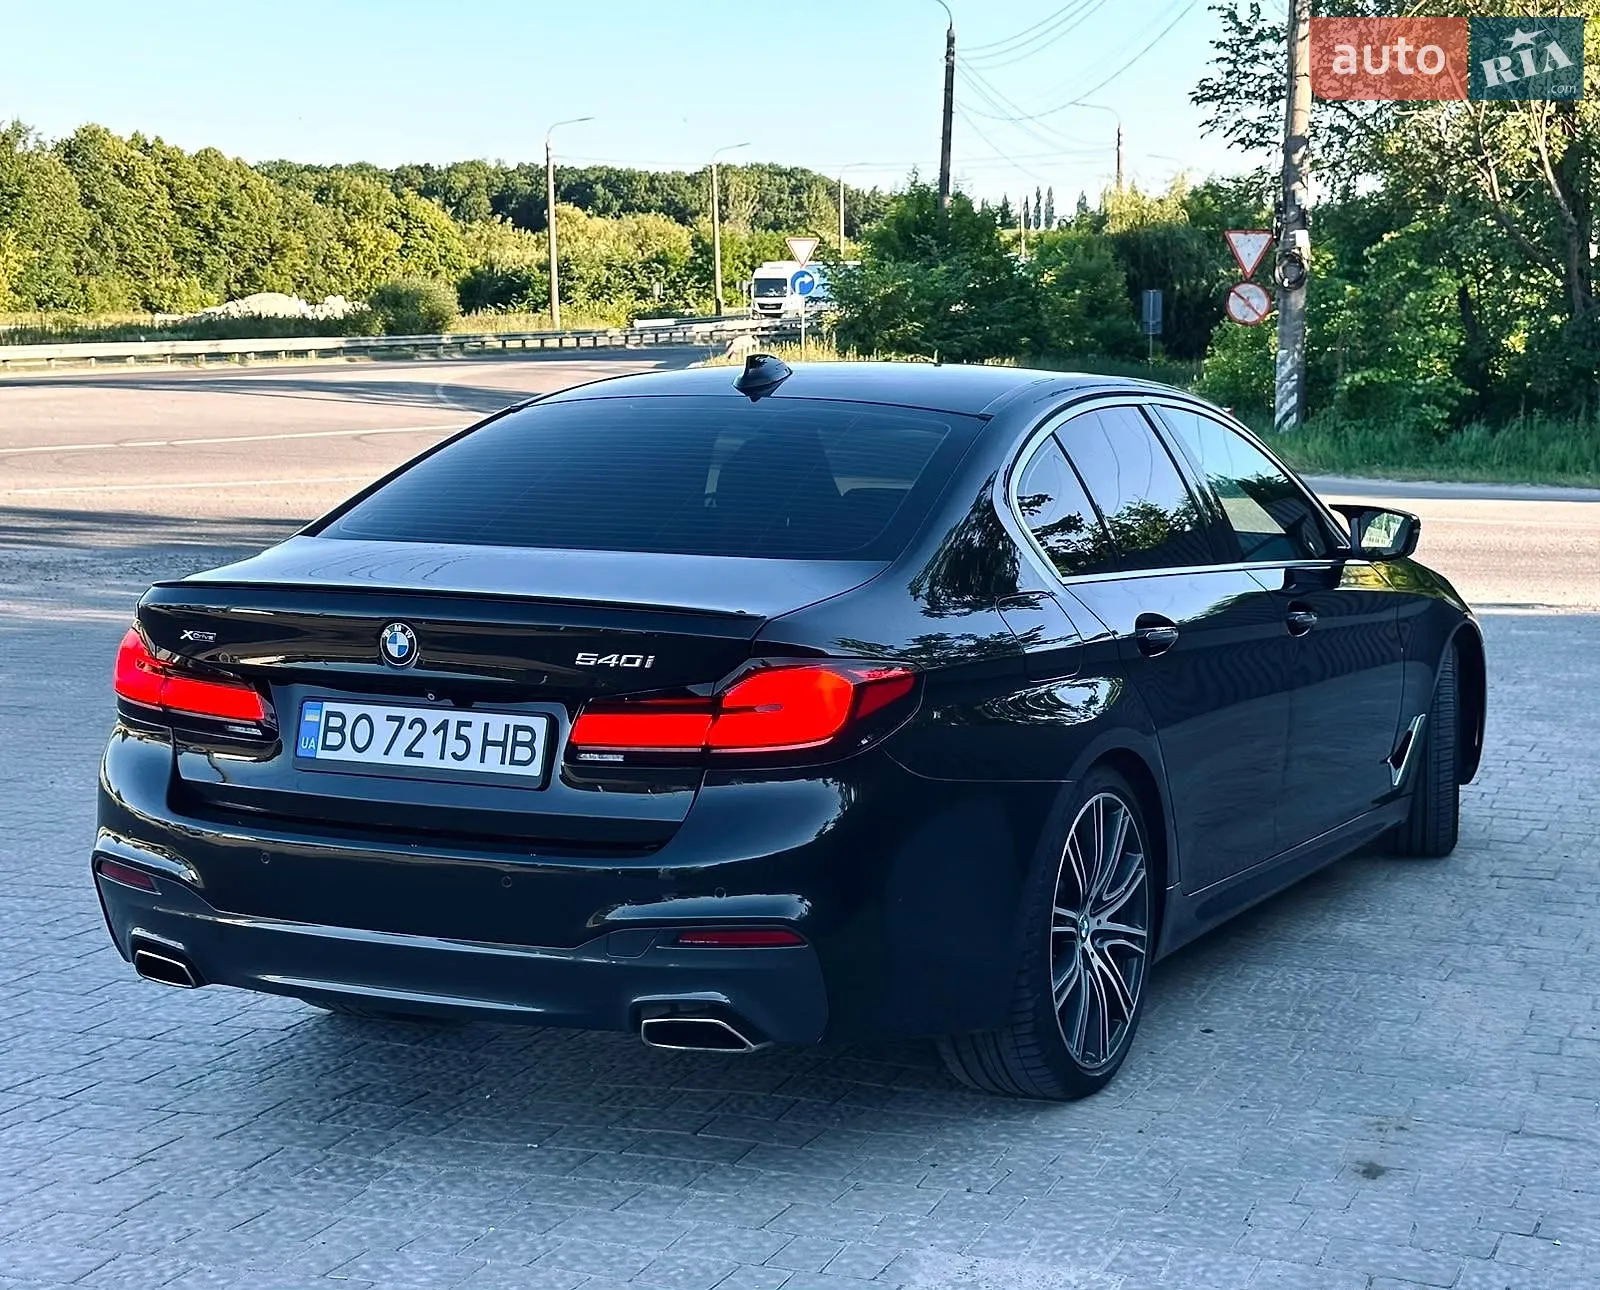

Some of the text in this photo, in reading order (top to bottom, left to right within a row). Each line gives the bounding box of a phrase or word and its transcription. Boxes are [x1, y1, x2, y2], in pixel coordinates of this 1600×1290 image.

[382, 624, 414, 639] BMW
[575, 652, 656, 669] 540i
[301, 736, 317, 750] UA
[320, 710, 537, 767] BO 7215 HB
